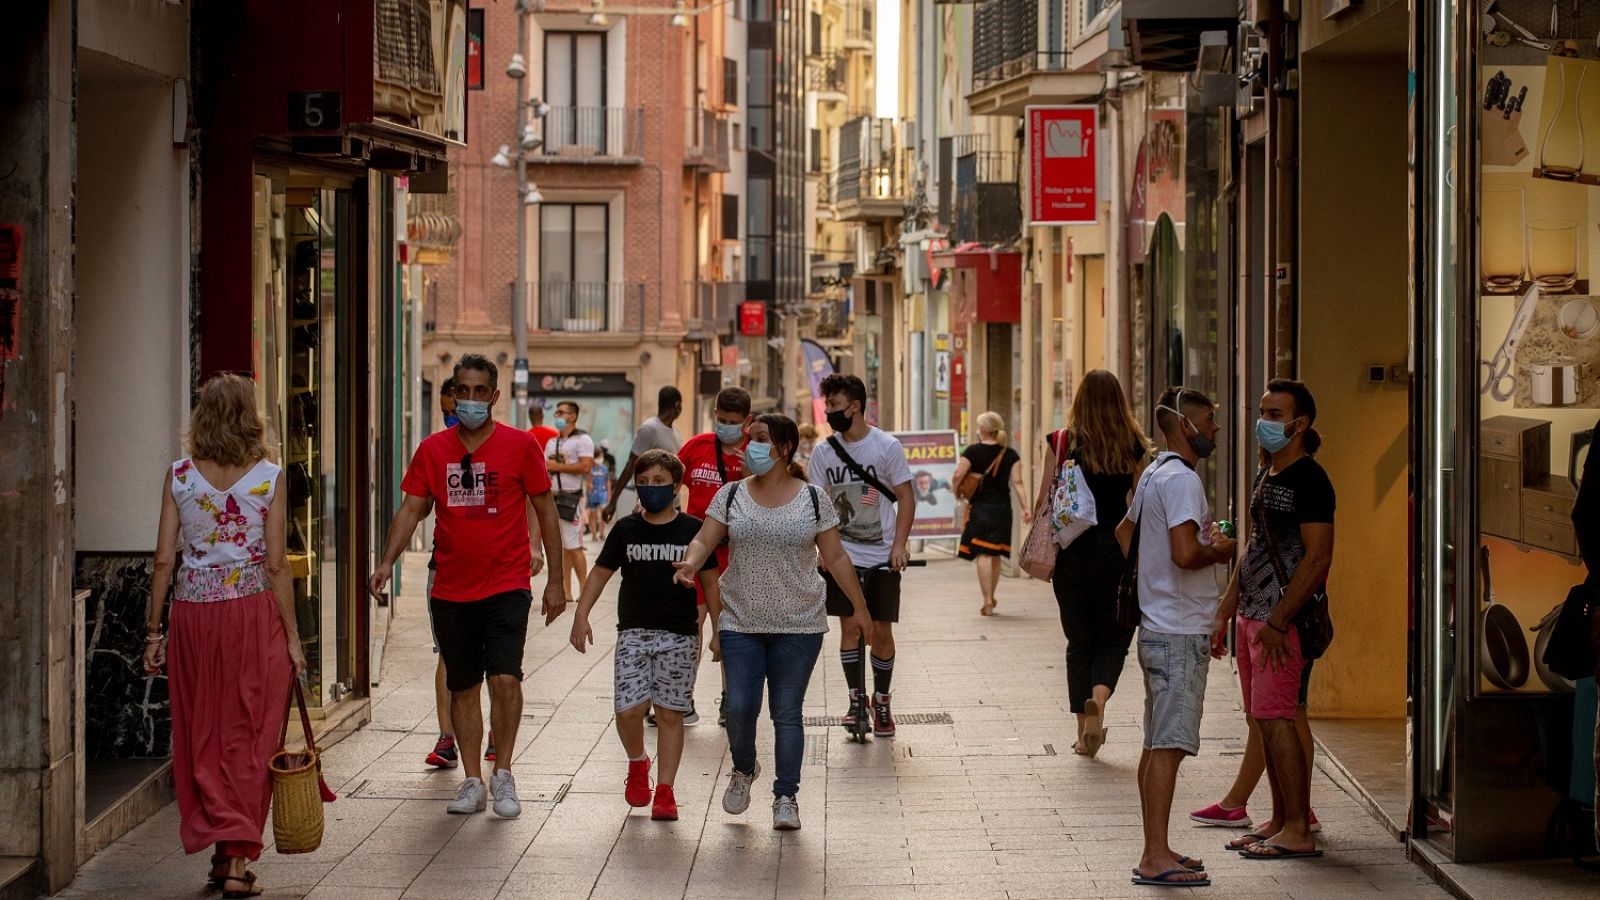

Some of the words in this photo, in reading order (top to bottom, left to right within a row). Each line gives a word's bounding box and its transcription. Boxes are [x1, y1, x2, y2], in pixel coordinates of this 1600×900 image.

[305, 93, 323, 127] 5
[1063, 188, 1075, 196] per
[542, 375, 583, 390] eva
[447, 472, 499, 488] CRE
[691, 468, 723, 482] CARDINA
